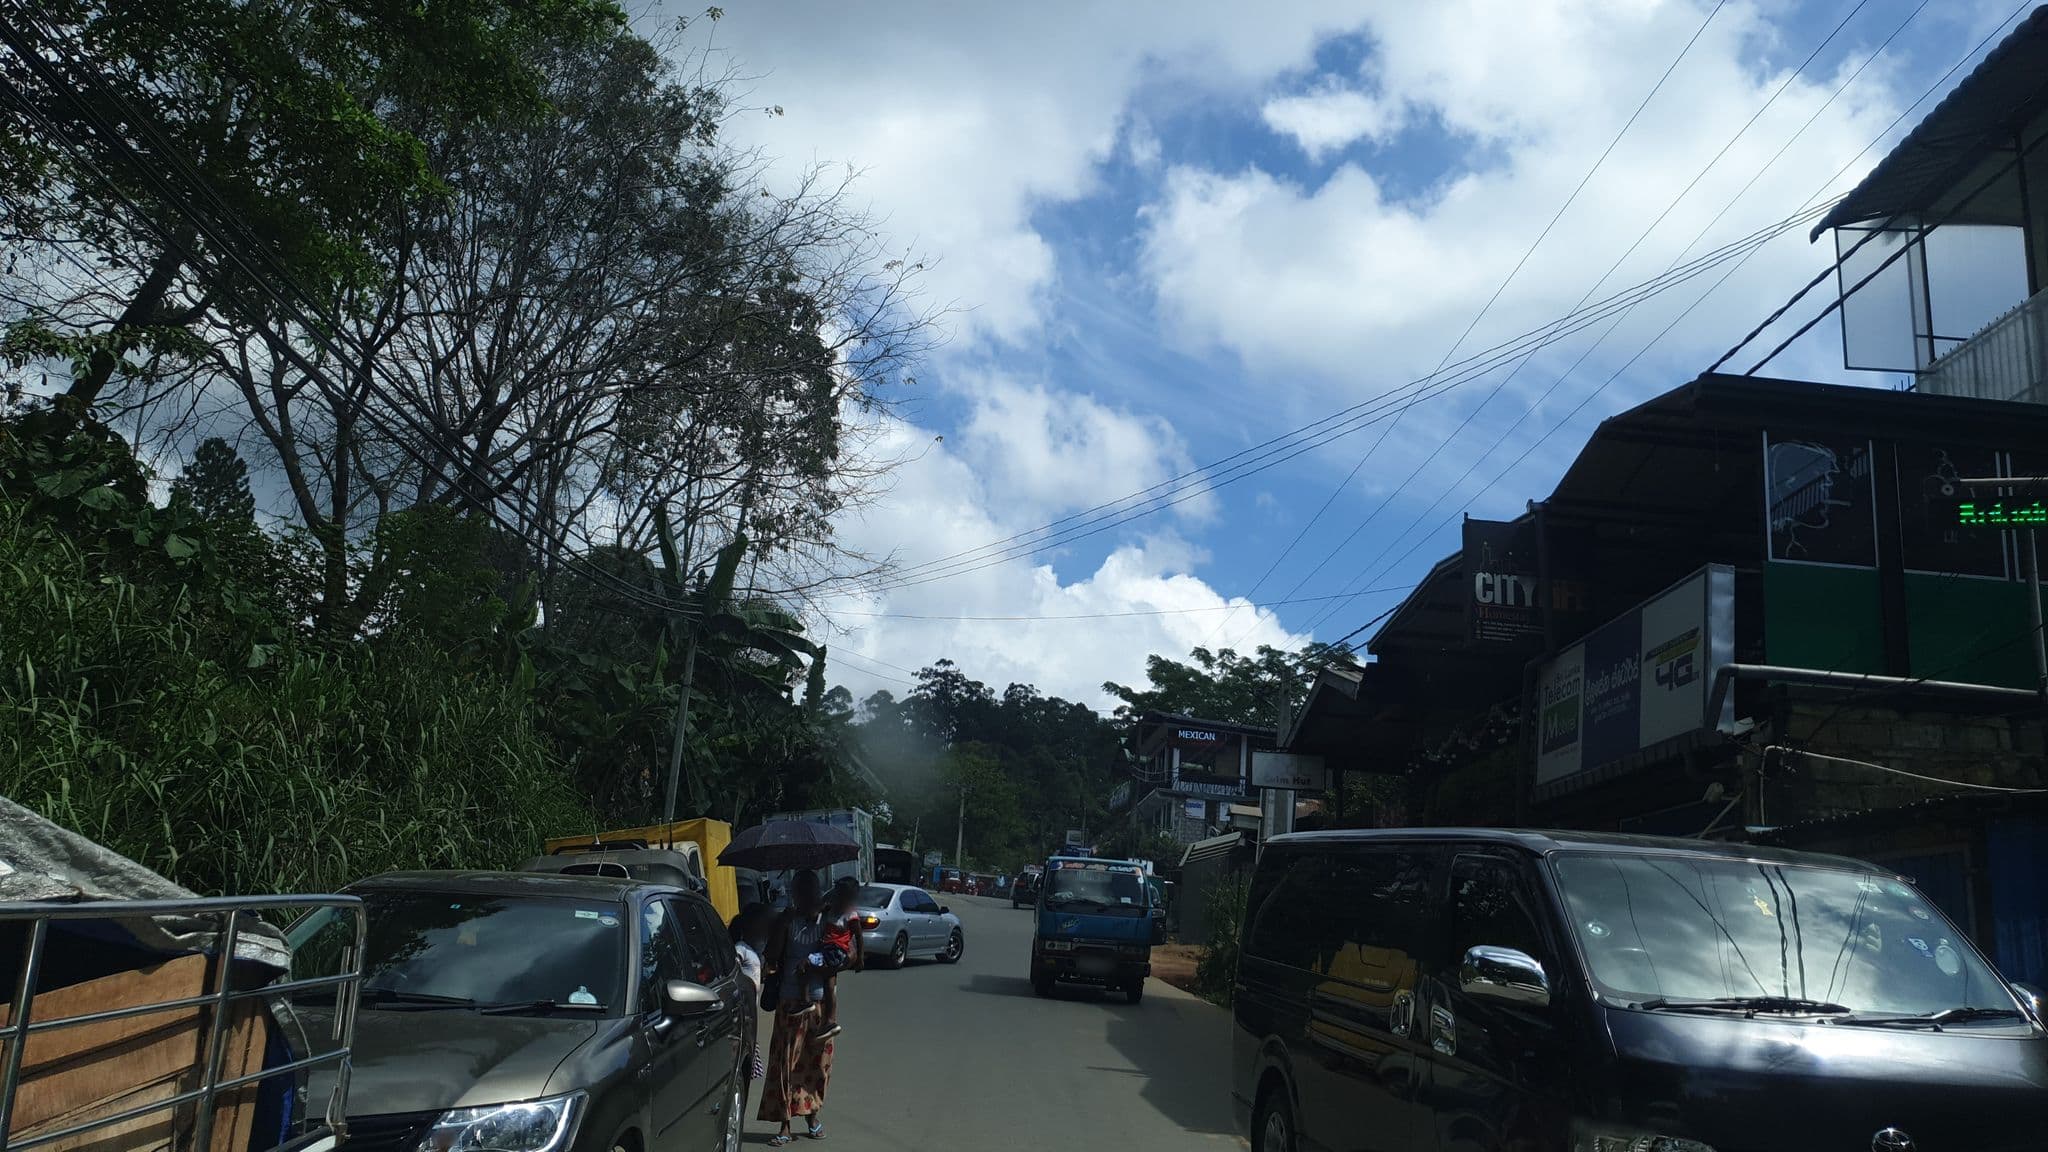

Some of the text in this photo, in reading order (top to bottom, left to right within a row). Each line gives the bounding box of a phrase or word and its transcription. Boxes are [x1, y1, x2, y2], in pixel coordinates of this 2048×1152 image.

[1475, 571, 1537, 607] CITY
[1544, 677, 1580, 705] Telecom
[1178, 729, 1216, 741] MEXICAN
